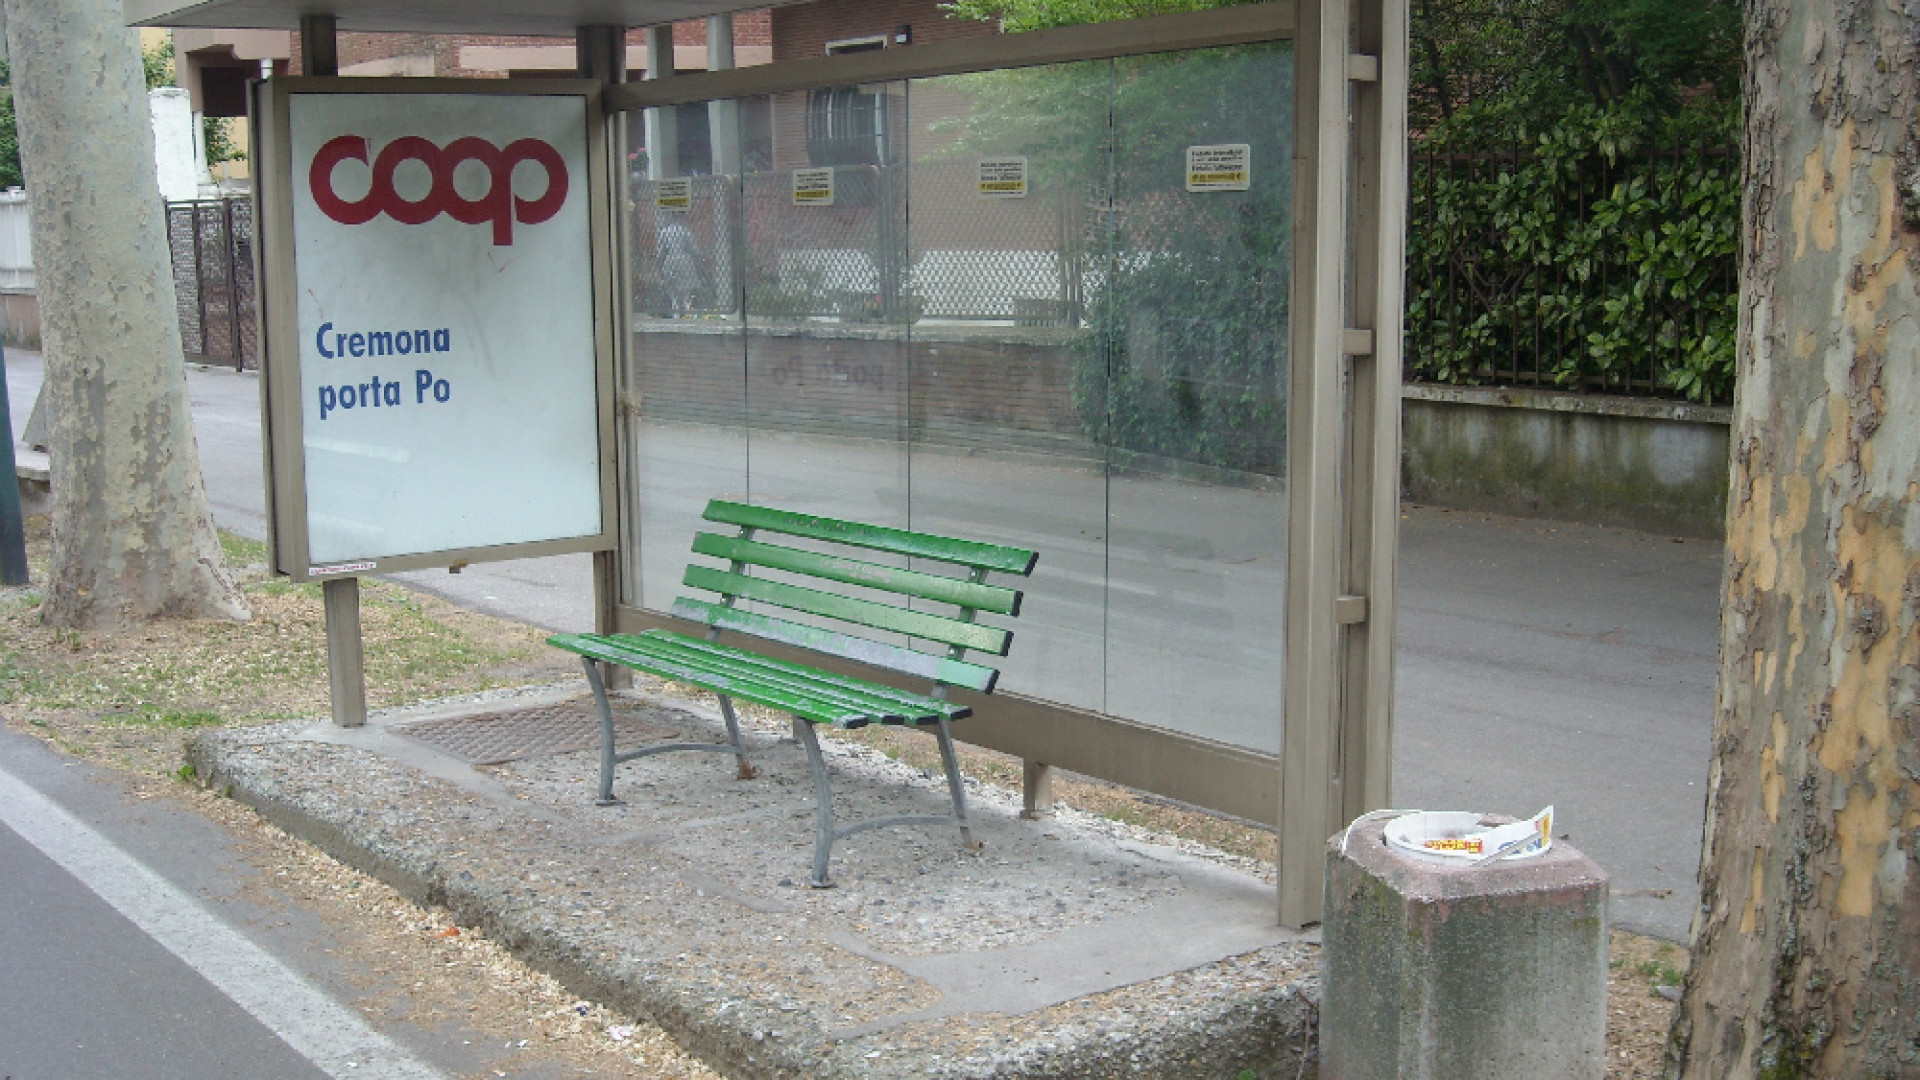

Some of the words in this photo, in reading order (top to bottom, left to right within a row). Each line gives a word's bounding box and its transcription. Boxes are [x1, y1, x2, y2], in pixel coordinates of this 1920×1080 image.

[309, 134, 569, 246] coop
[316, 322, 450, 359] Cremona
[318, 375, 401, 420] porta
[415, 369, 450, 403] Po
